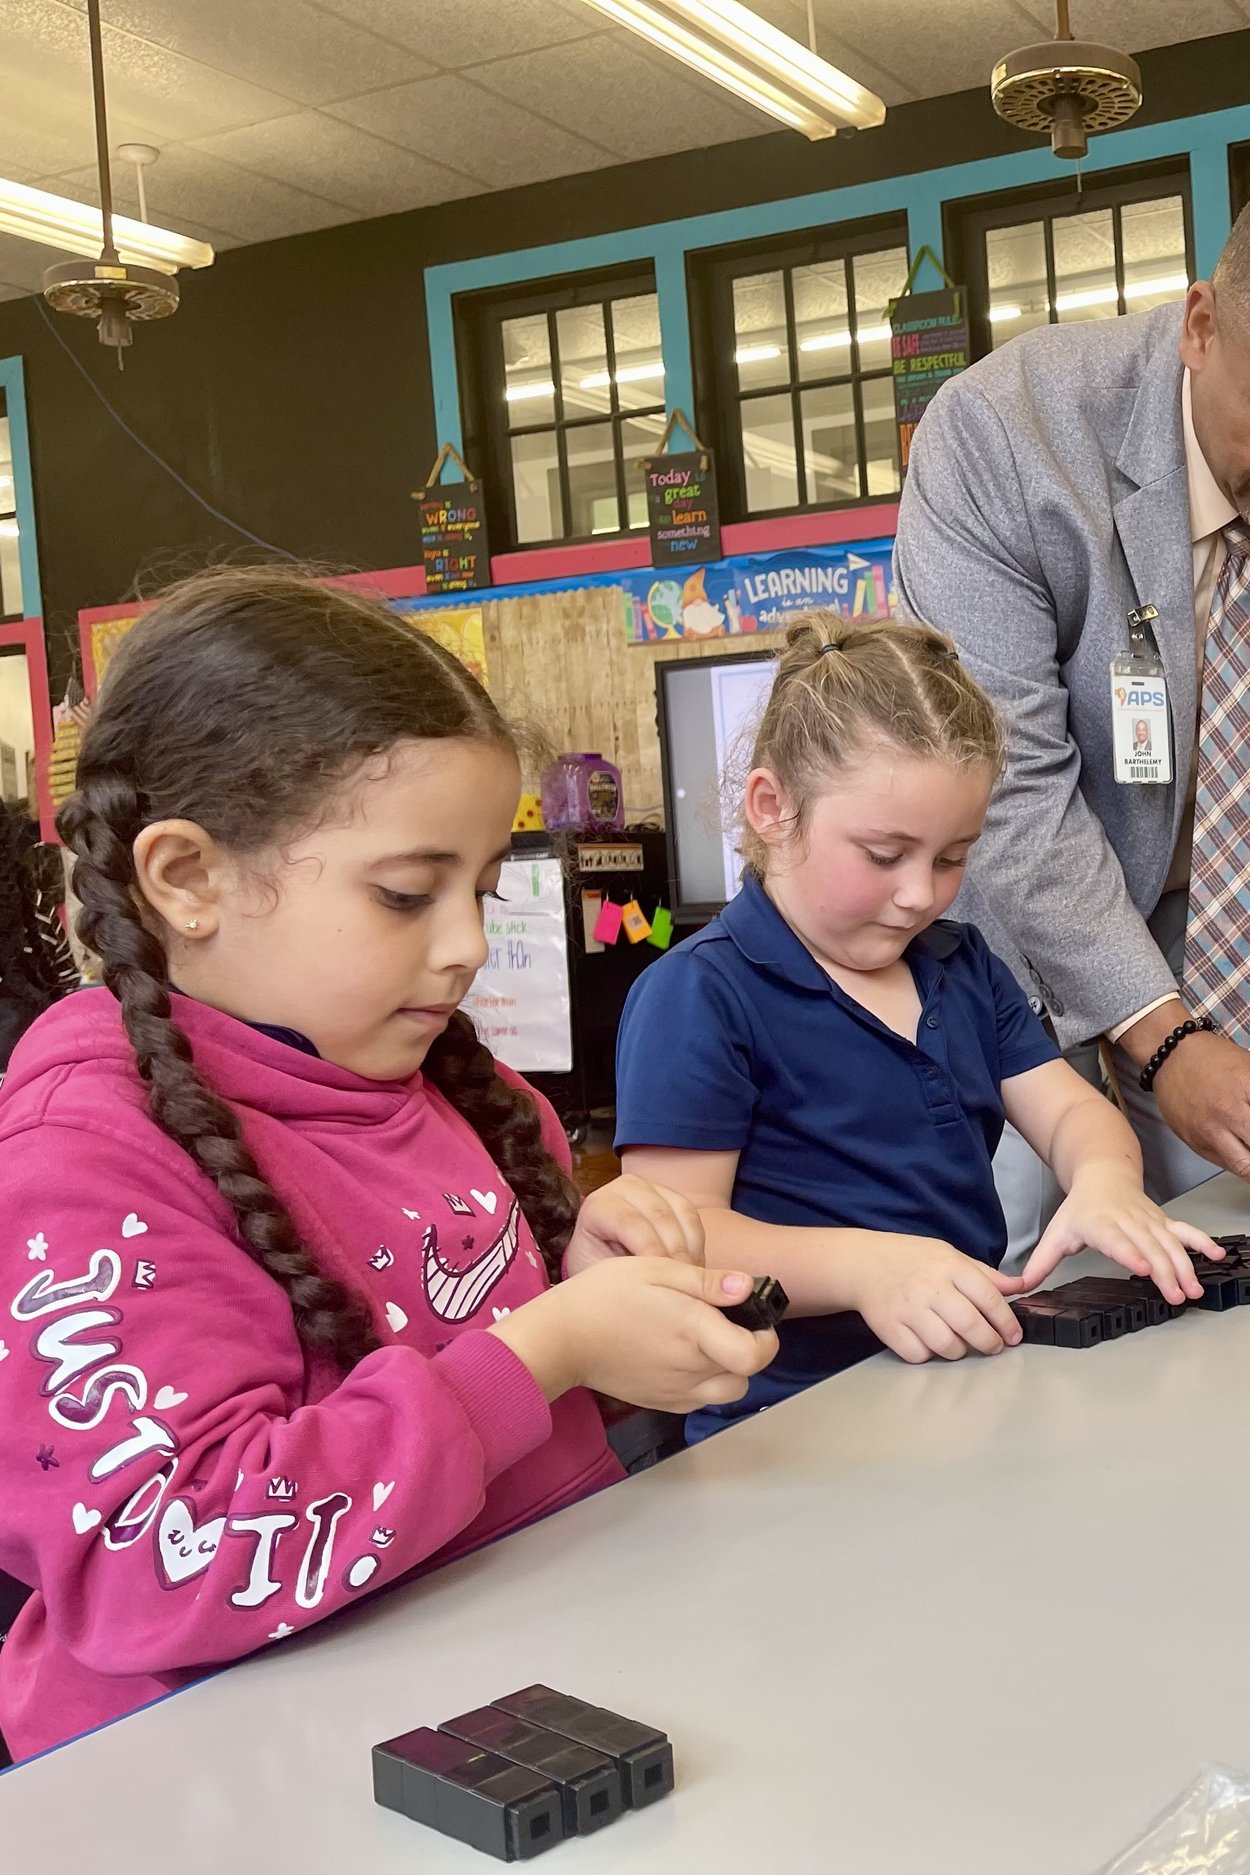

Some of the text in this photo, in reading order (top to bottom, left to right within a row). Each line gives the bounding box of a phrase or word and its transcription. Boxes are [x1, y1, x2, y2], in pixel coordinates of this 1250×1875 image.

[893, 352, 967, 374] BE RESPECTFUL
[649, 468, 692, 487] Today
[664, 484, 702, 505] great
[672, 509, 708, 526] learn
[656, 524, 711, 541] something
[670, 538, 699, 553] new
[744, 566, 849, 605] LEARNING
[1127, 690, 1165, 707] APS
[1124, 758, 1163, 766] BARTHELEMY
[10, 1249, 179, 1484] JUST
